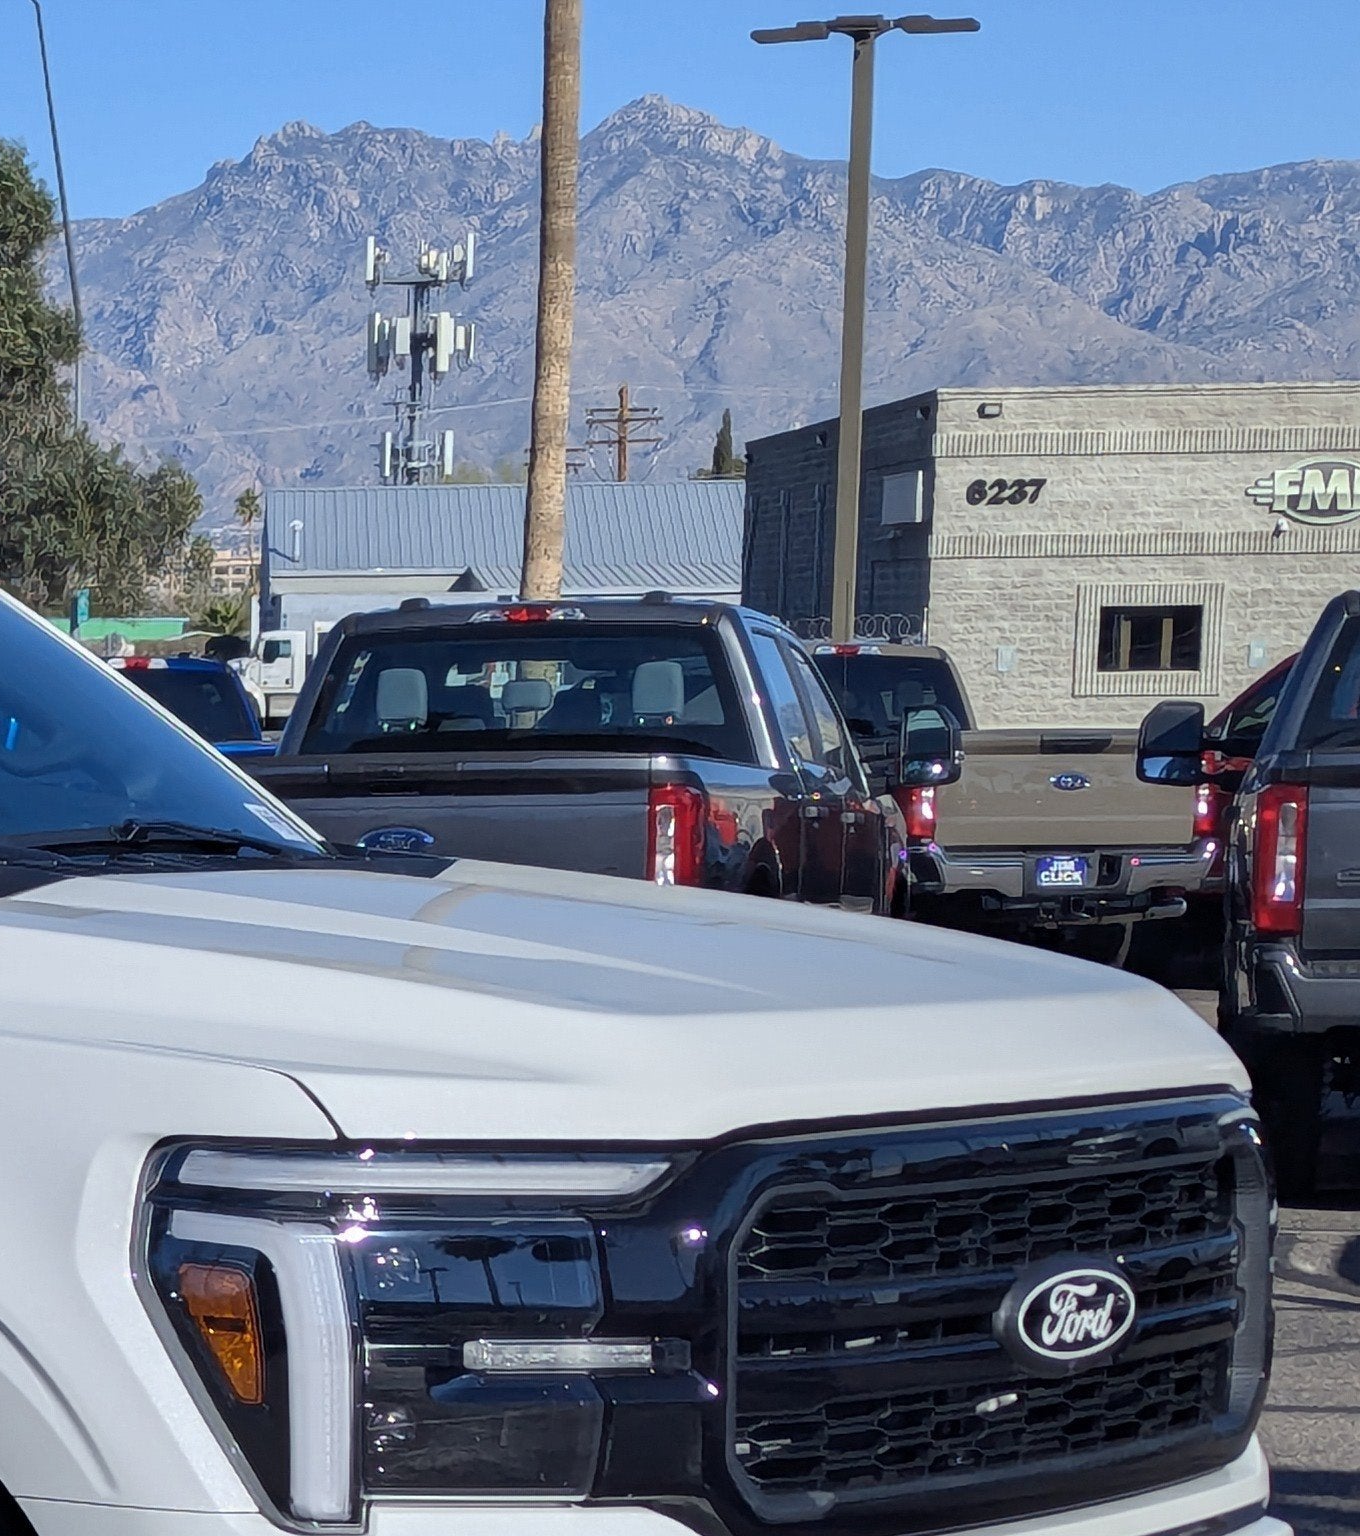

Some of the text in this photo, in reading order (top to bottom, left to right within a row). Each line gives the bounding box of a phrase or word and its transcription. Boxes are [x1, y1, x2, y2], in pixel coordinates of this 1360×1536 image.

[966, 478, 1047, 506] 6237
[1040, 870, 1083, 882] CLICK
[1041, 1282, 1115, 1346] Ford
